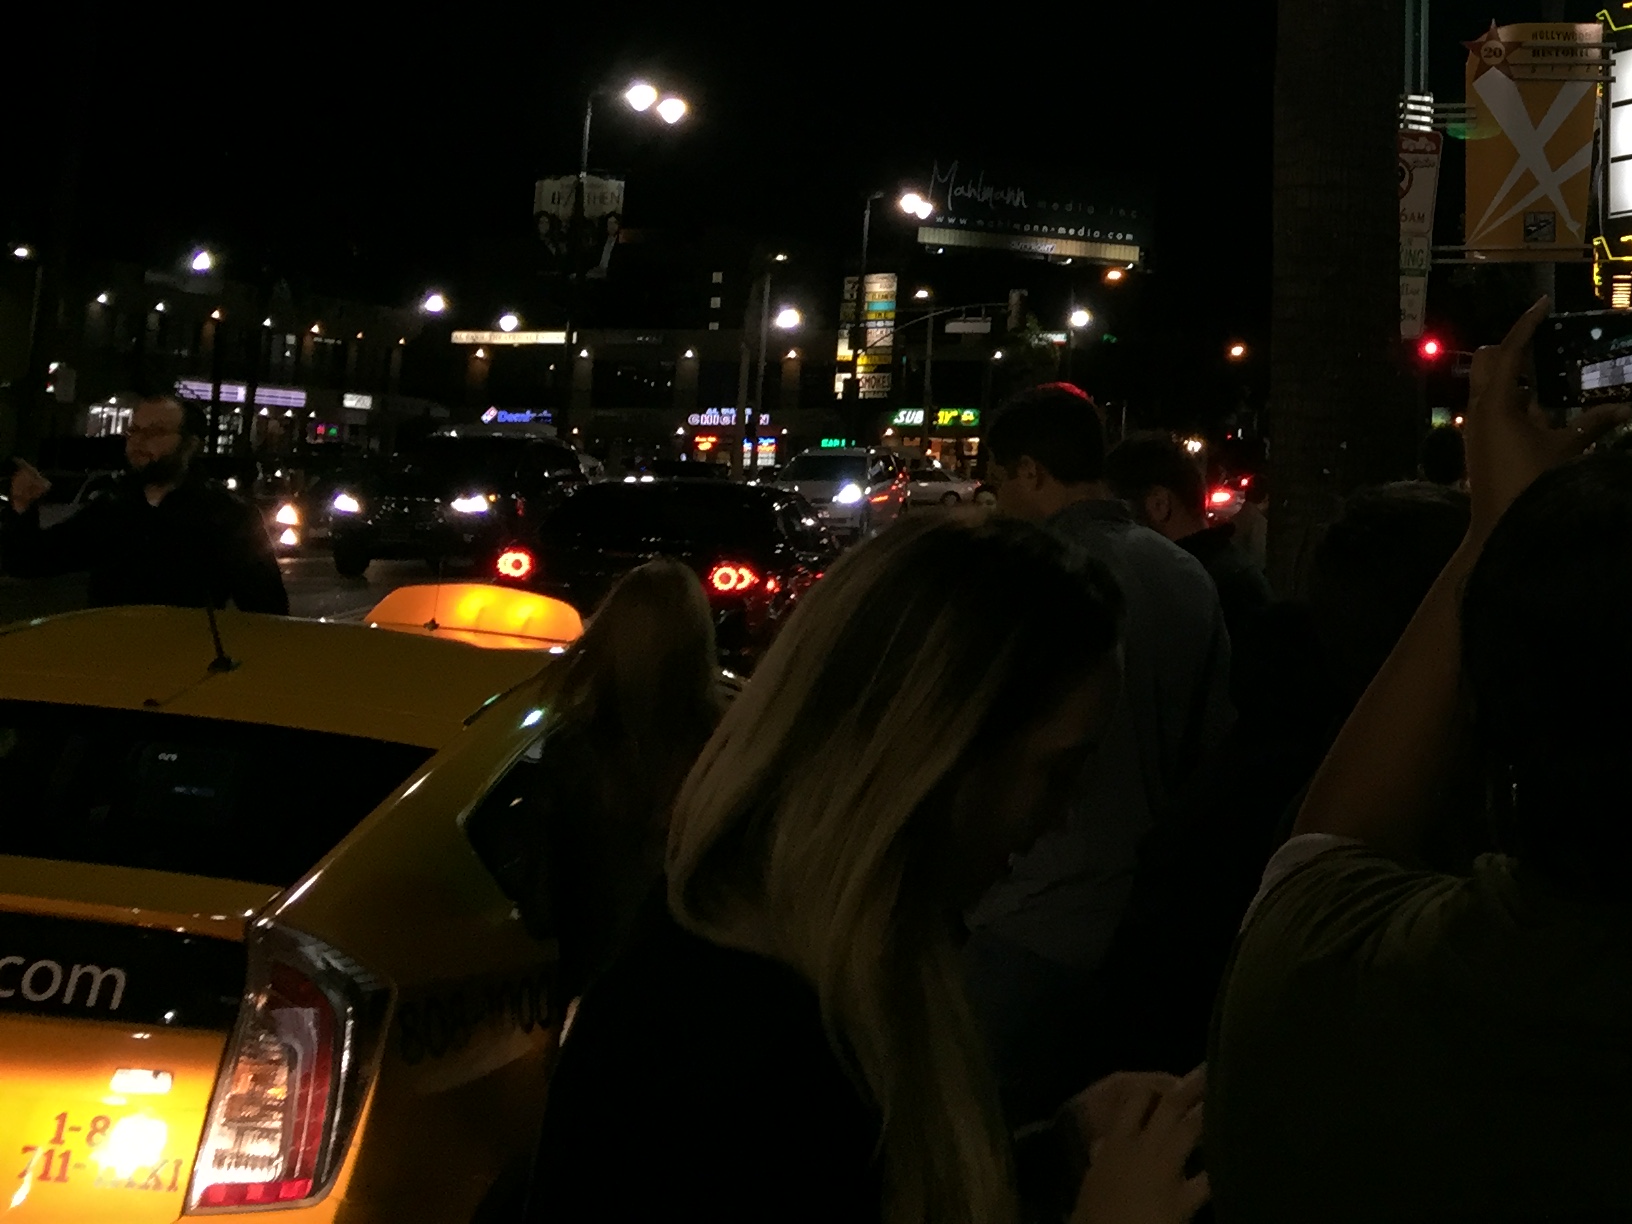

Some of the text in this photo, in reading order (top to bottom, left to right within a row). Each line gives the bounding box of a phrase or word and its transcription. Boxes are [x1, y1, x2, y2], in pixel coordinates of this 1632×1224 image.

[1483, 47, 1503, 59] 20
[928, 158, 1029, 213] Mahlmann
[688, 413, 770, 426] CHICN
[893, 408, 960, 425] SUBAY
